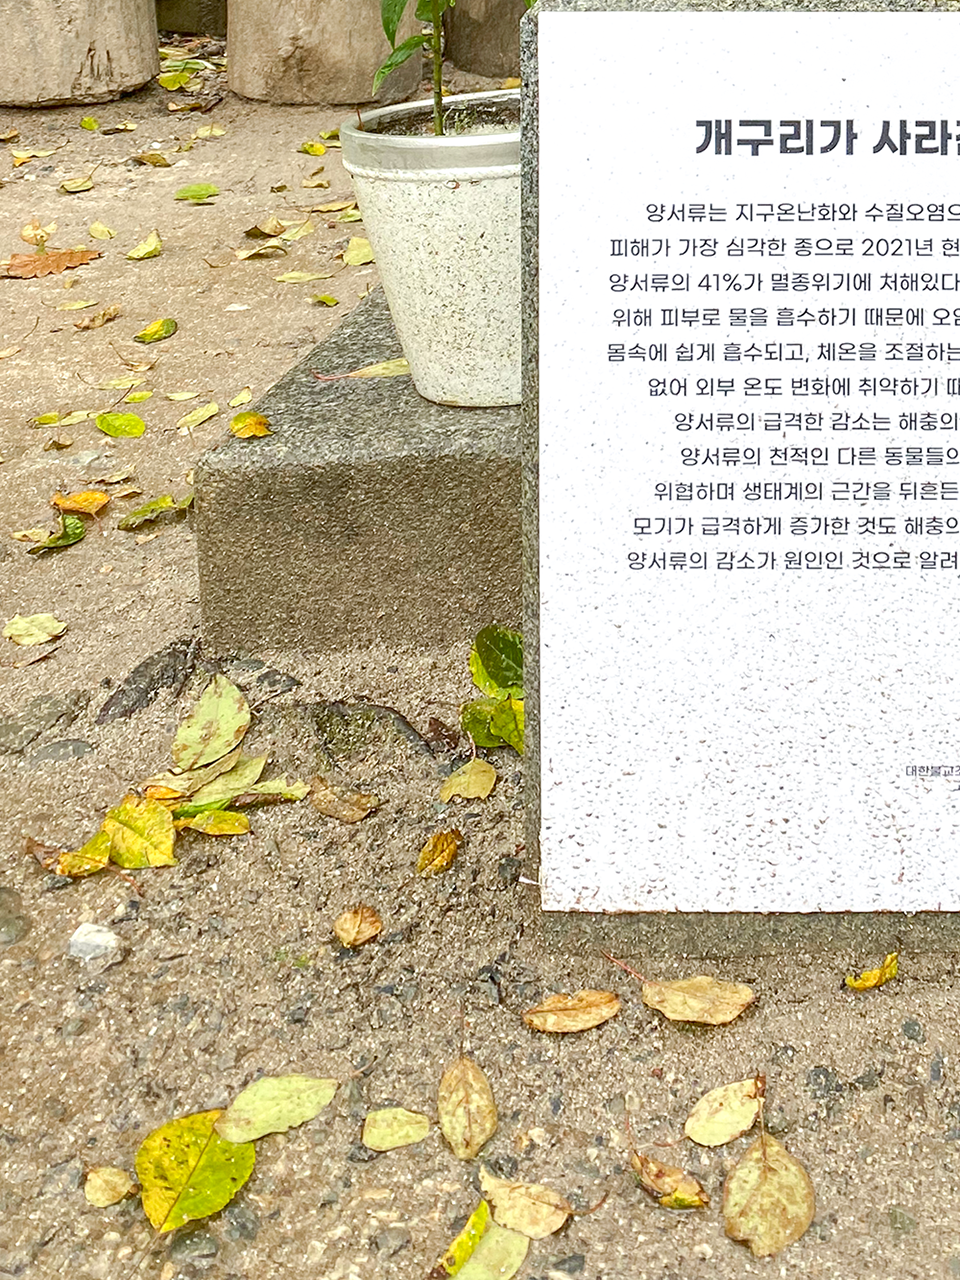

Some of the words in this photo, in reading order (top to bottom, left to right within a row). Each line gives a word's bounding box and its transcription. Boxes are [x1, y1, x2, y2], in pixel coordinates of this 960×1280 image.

[695, 119, 858, 157] 개구리가
[645, 203, 728, 223] 양서류는
[735, 202, 858, 223] 지구온난화와
[610, 238, 671, 258] 피해가
[678, 238, 719, 258] 가장
[726, 237, 787, 257] 심각한
[793, 237, 855, 257] 종으로
[861, 238, 933, 257] 2021년
[609, 273, 690, 293] 양서류의
[697, 272, 764, 292] 41%가
[771, 272, 872, 292] 멸종위기에
[612, 308, 652, 328] 위해
[660, 307, 721, 328] 피부로
[728, 307, 769, 327] 물을
[776, 306, 856, 327] 흡수하기
[864, 307, 924, 327] 때문에
[607, 342, 667, 362] 몸속에
[675, 342, 715, 362] 쉽게
[723, 342, 809, 364] 흡수되고,
[816, 342, 877, 362] 체온을
[648, 377, 687, 397] 없어
[695, 377, 736, 397] 외부
[743, 377, 783, 397] 온도
[791, 377, 851, 397] 변화에
[858, 376, 938, 397] 취약하기
[674, 412, 755, 432] 양서류의
[762, 411, 824, 432] 급격한
[831, 412, 891, 431] 감소는
[898, 411, 958, 432] 해충의
[680, 447, 761, 467] 양서류의
[769, 446, 829, 466] 천적인
[837, 446, 877, 466] 다른
[654, 482, 734, 501] 위협하며
[742, 481, 823, 501] 생태계의
[831, 481, 892, 501] 근간을
[633, 517, 695, 536] 모기가
[701, 516, 782, 536] 급격하게
[789, 516, 851, 536] 증가한
[857, 516, 897, 536] 것도
[627, 551, 707, 571] 양서류의
[716, 551, 777, 572] 감소가
[783, 550, 843, 570] 원인인
[852, 549, 912, 570] 것으로
